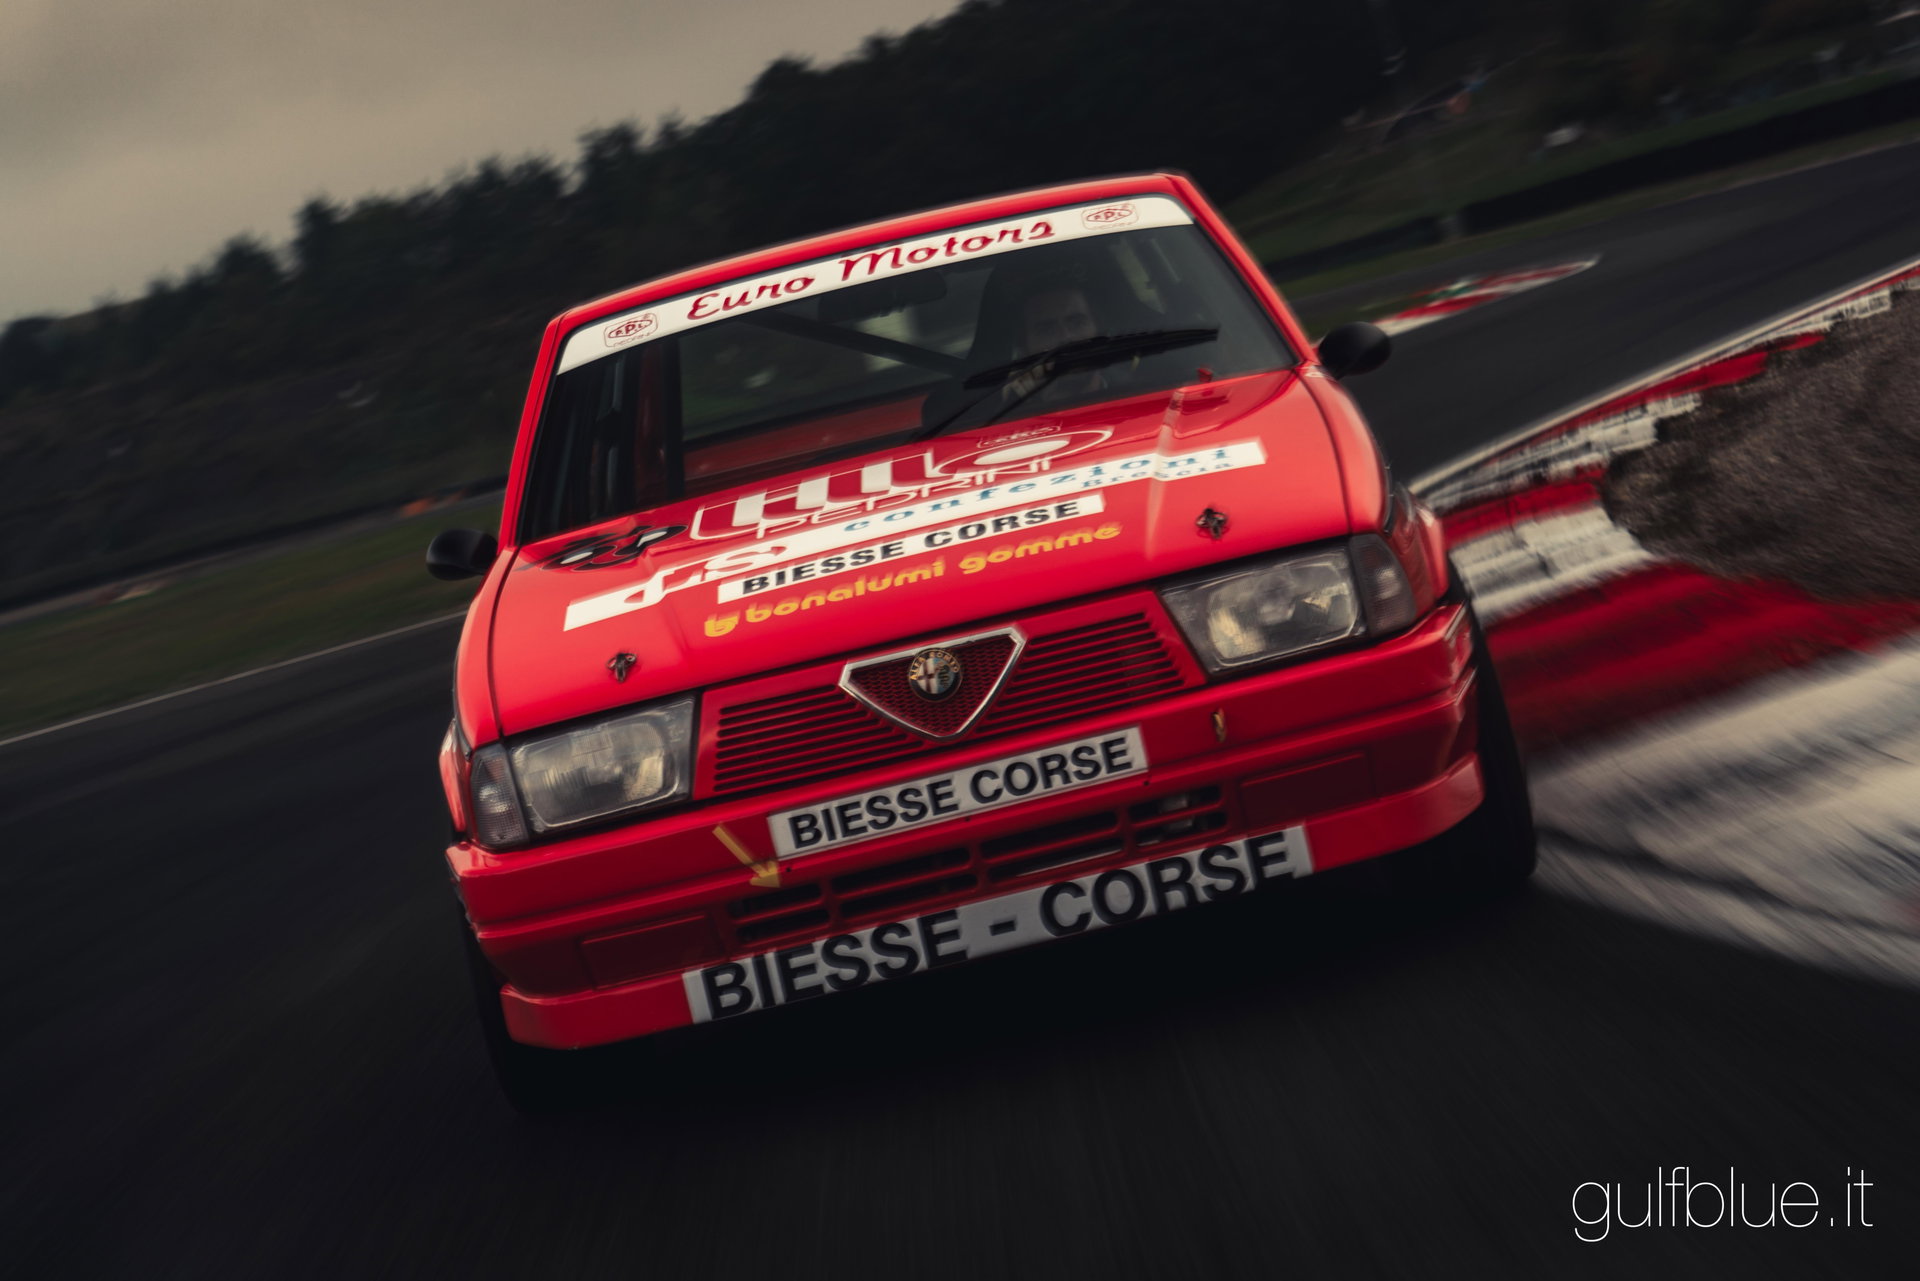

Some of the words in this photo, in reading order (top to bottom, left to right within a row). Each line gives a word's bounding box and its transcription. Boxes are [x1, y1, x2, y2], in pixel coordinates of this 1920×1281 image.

[687, 276, 815, 321] Euro
[838, 221, 1056, 282] Motors
[756, 458, 1051, 540] PEDRINI
[844, 446, 1232, 532] confezioni
[1082, 462, 1234, 489] Brescia
[742, 540, 905, 595] BIESSE
[923, 500, 1080, 549] CORSE
[745, 561, 945, 624] bonalumi
[958, 525, 1122, 575] gomme
[910, 656, 926, 680] ALFA
[929, 651, 960, 673] ROMEO
[788, 776, 959, 849] BIESSE
[969, 736, 1133, 805] CORSE
[700, 909, 968, 1020] BIESSE
[989, 919, 1016, 936] -
[1040, 831, 1296, 939] CORSE
